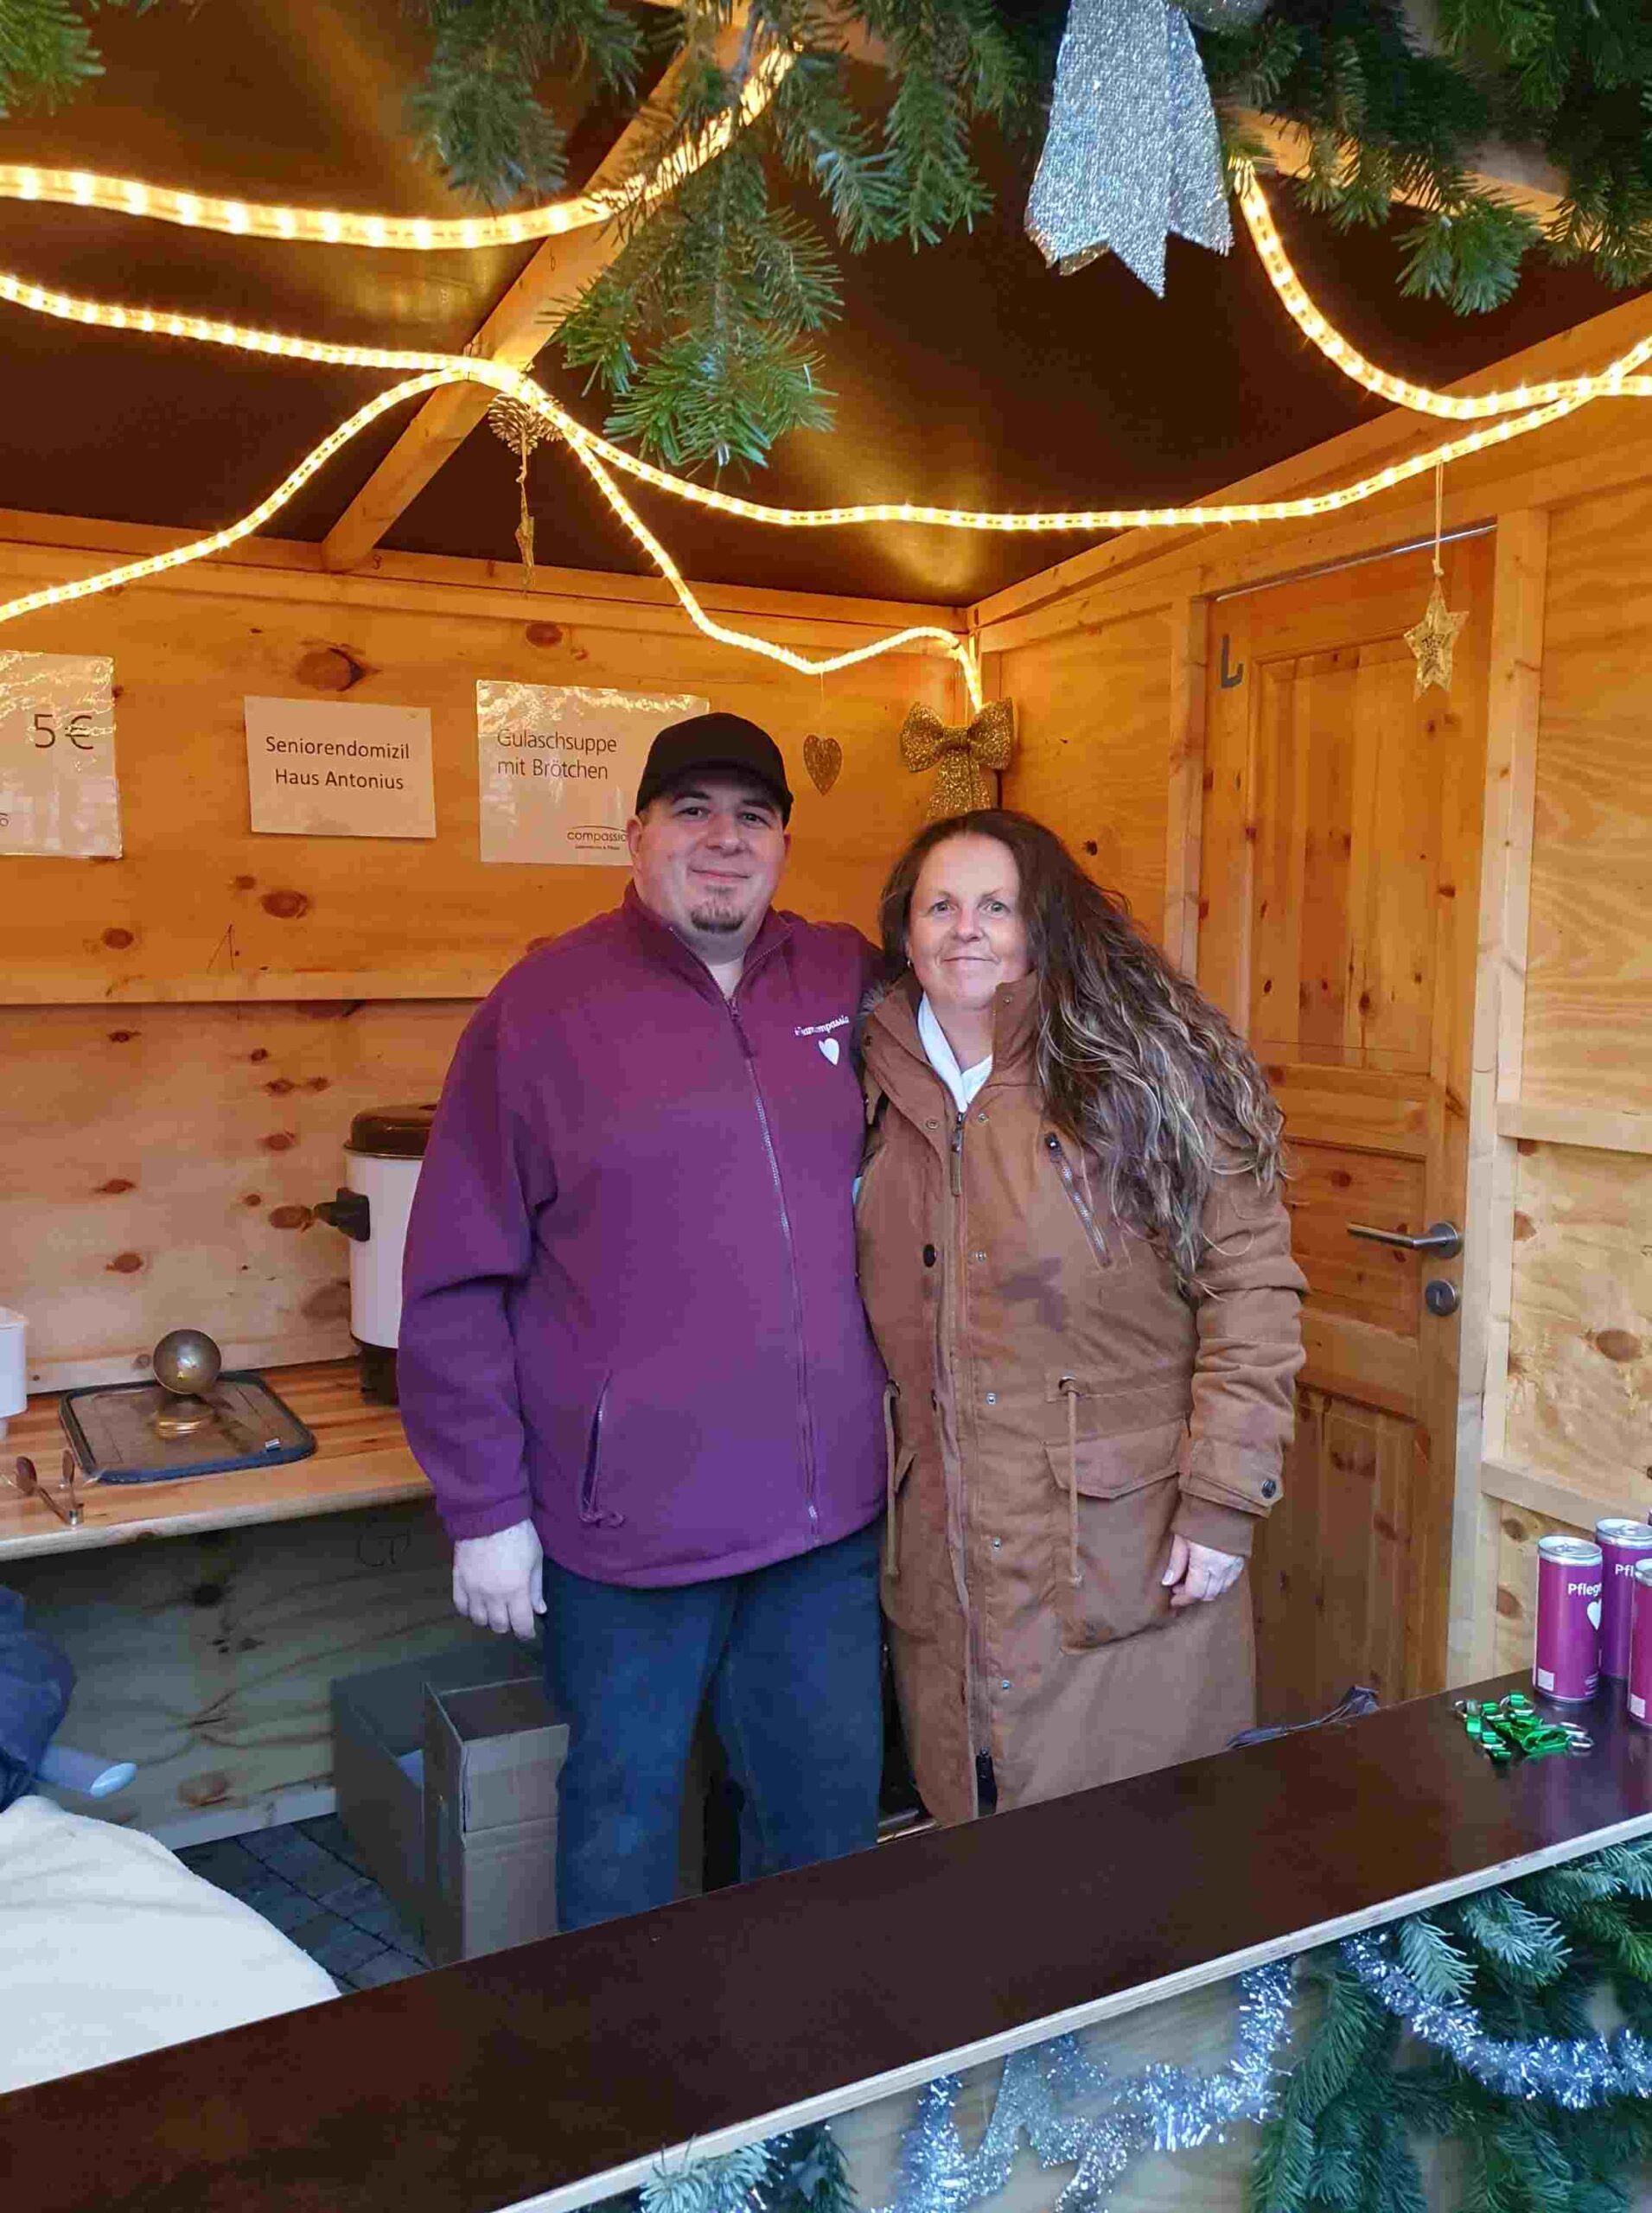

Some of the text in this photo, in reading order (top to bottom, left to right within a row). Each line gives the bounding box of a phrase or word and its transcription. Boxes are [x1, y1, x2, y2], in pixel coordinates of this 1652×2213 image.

[265, 736, 411, 760] Seniorendomizil
[496, 728, 618, 756] Gulaschsuppe
[275, 768, 405, 791] Haus Antonius
[497, 758, 609, 780] mit Brötchen
[1614, 1563, 1634, 1578] Pfl
